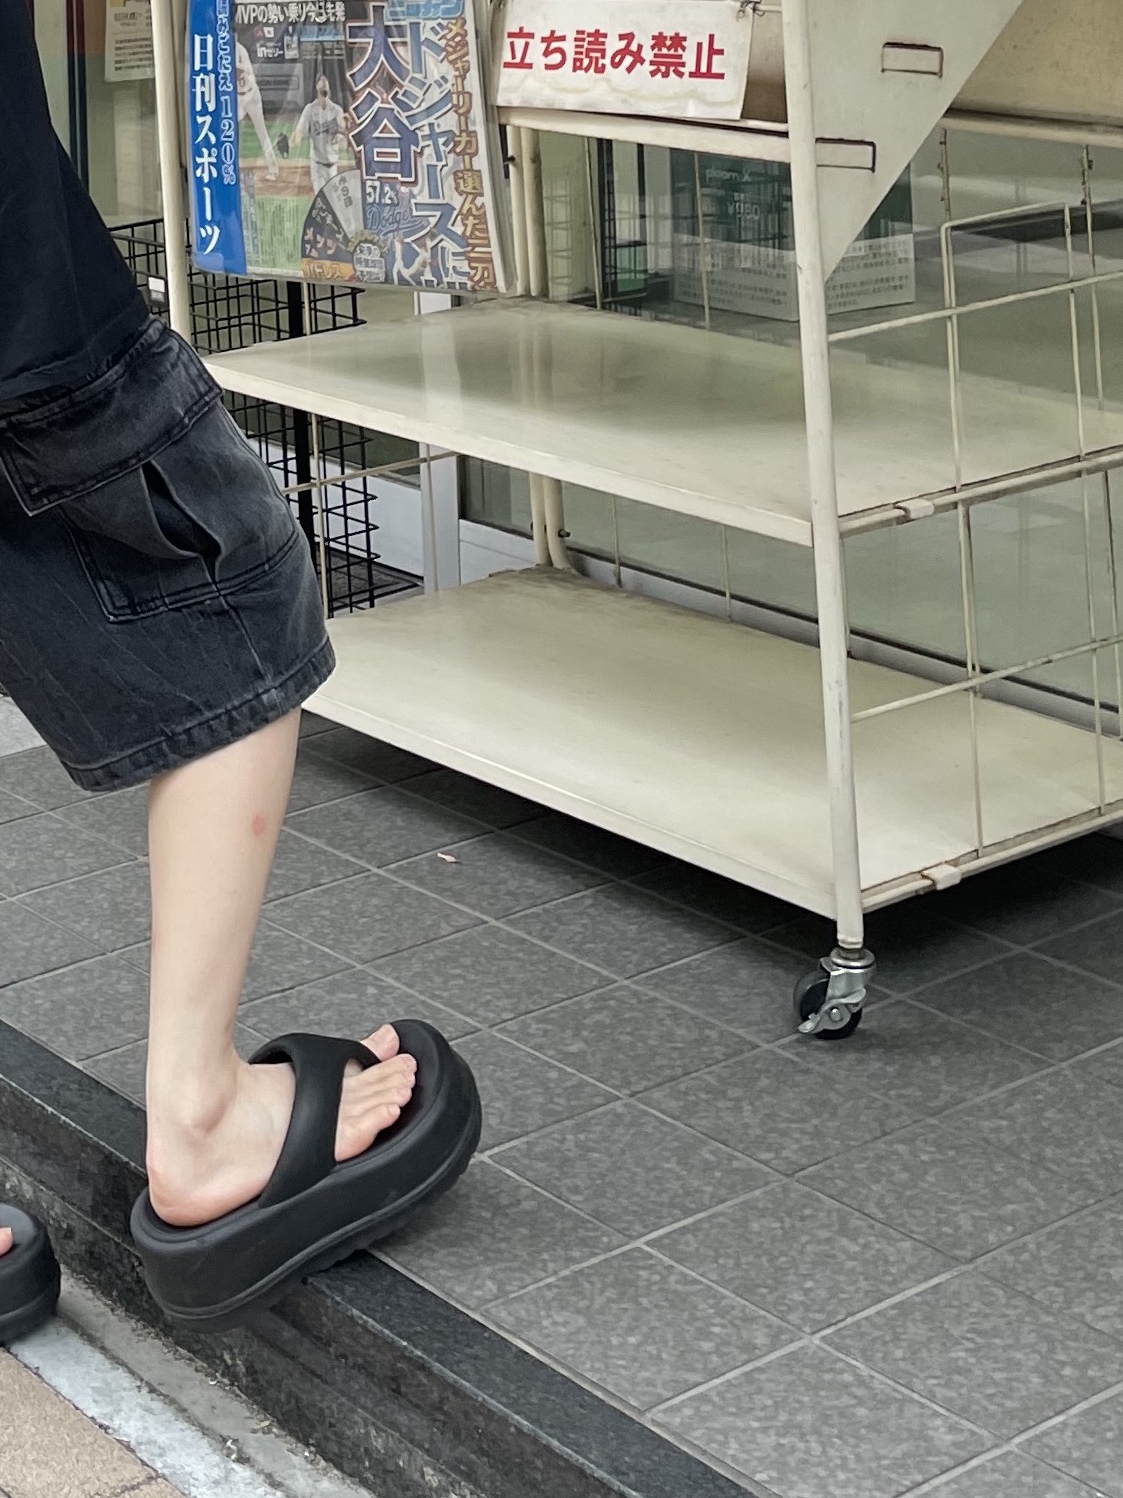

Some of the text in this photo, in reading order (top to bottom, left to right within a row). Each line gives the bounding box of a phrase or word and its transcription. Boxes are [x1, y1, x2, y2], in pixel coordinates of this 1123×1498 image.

[347, 3, 424, 183] 大谷
[503, 26, 725, 80] 立ち読み禁止
[192, 33, 219, 255] 日刊スポーツ
